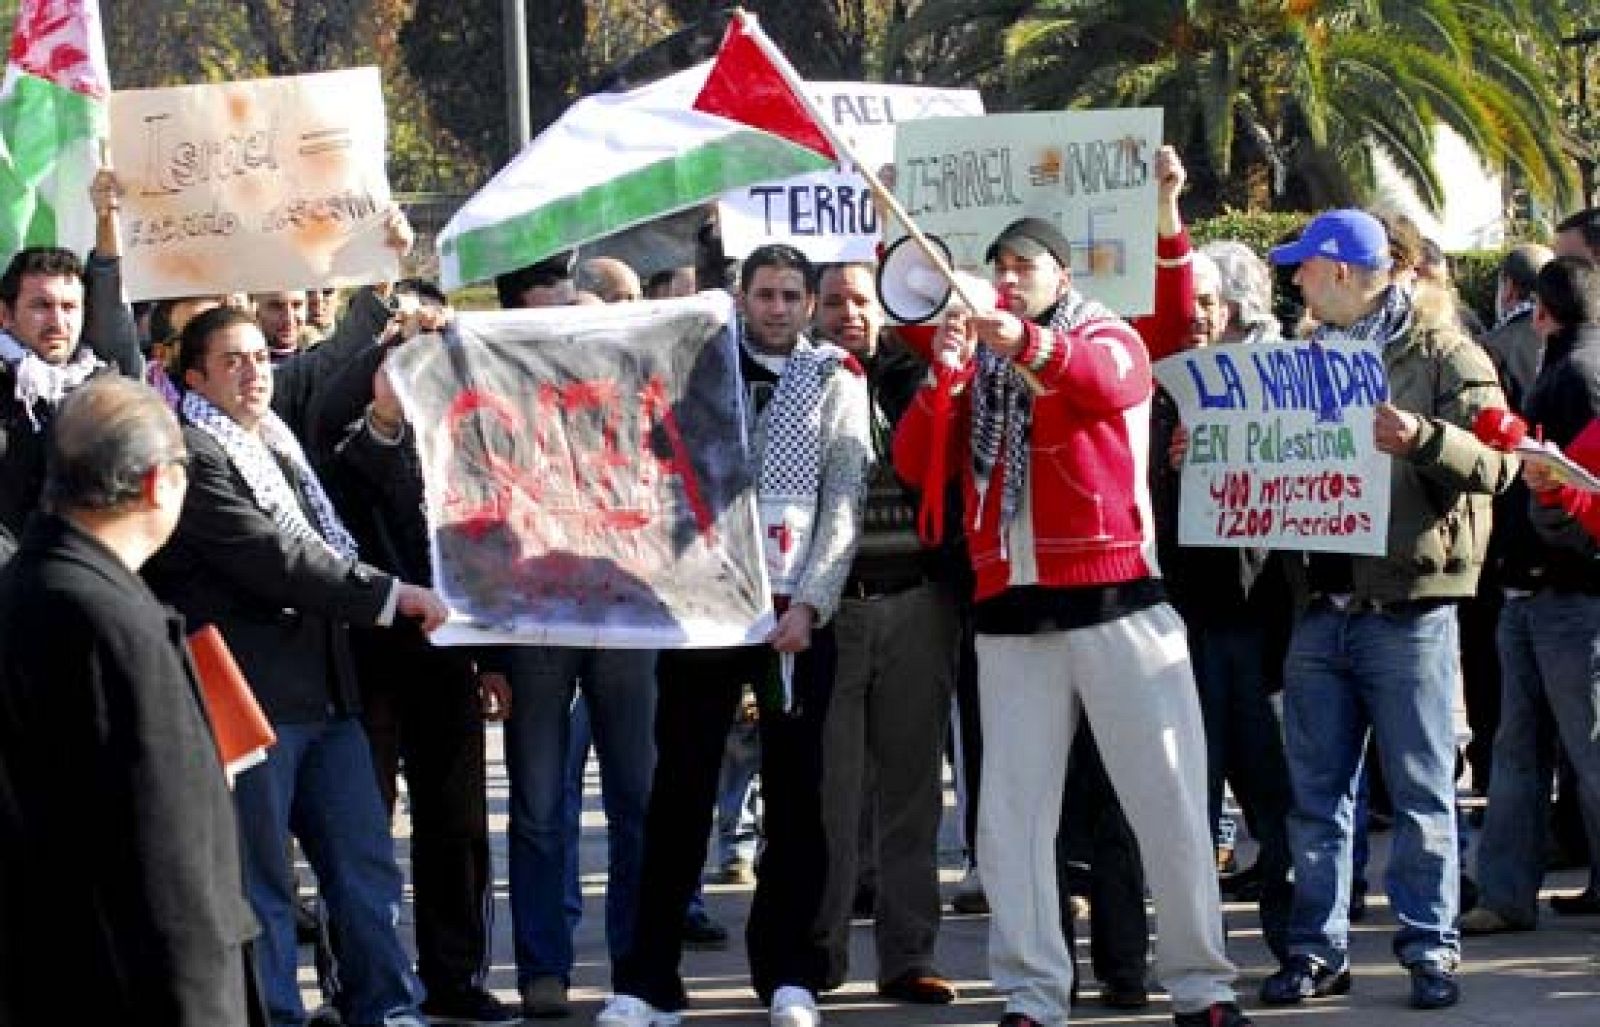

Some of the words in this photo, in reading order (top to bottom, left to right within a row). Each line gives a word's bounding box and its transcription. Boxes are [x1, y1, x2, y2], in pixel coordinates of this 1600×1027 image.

[907, 147, 1023, 216] ISRAEL
[750, 185, 876, 236] TERRO
[1186, 354, 1246, 409] LA
[1190, 423, 1229, 465] EN
[1216, 509, 1273, 539] 1200
